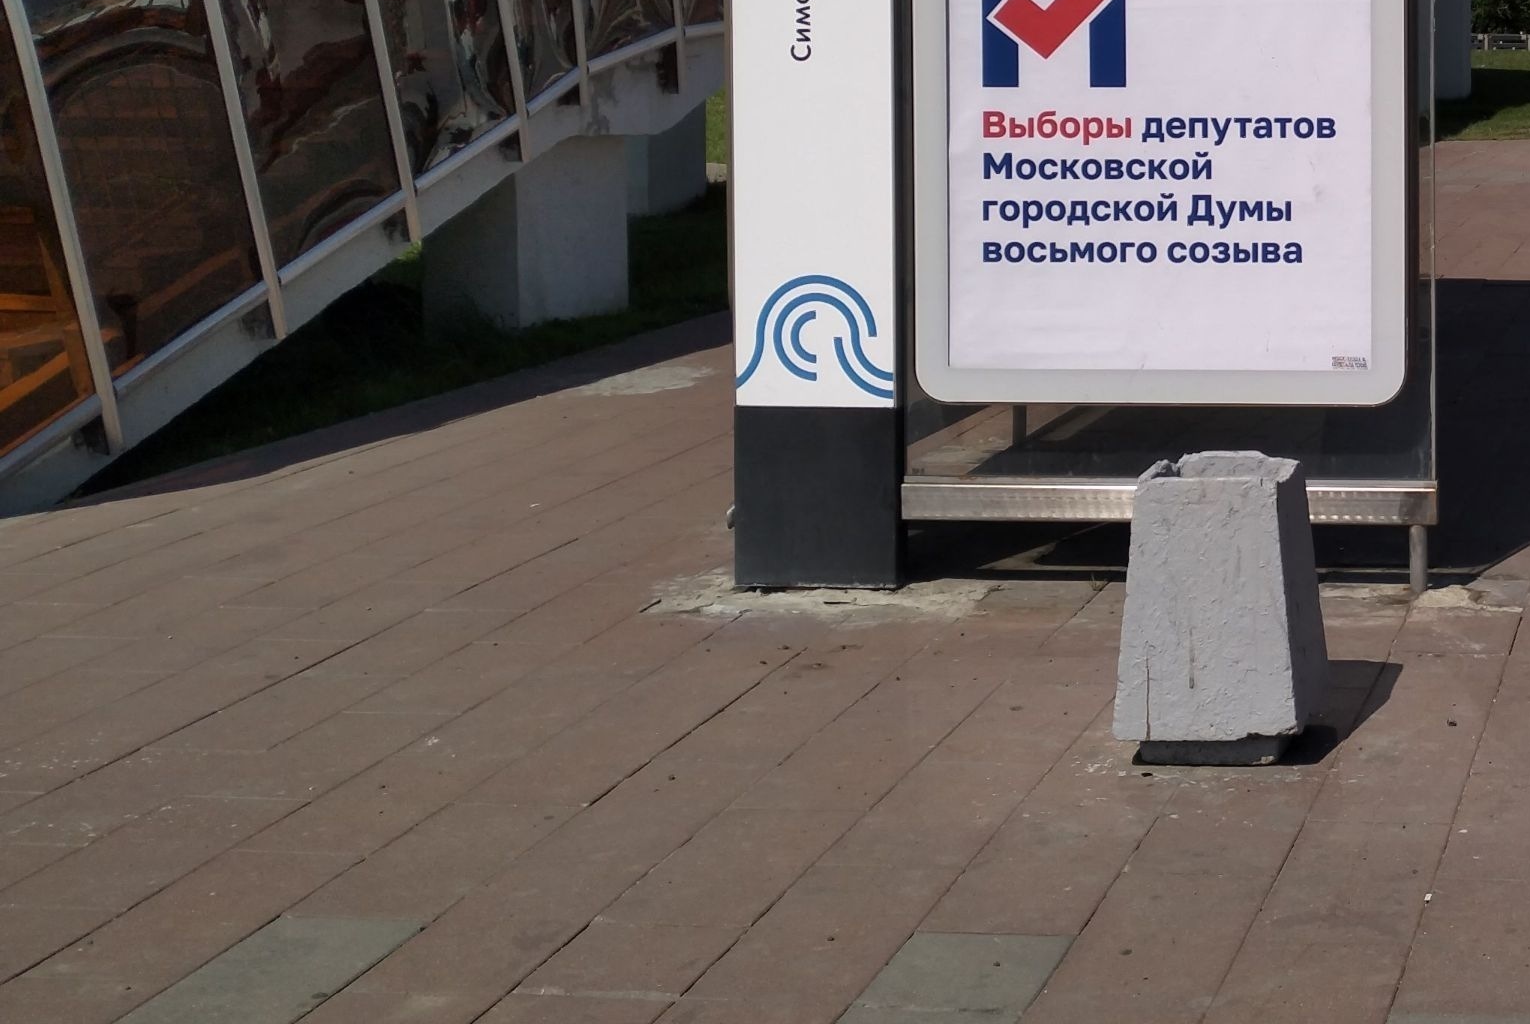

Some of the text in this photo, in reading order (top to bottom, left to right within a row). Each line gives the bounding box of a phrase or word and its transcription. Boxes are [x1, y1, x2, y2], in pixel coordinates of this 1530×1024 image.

[982, 111, 1337, 146] Выборы депутатов
[982, 151, 1213, 180] Московской
[982, 193, 1292, 229] городской Думы
[982, 241, 1304, 263] восьмого созыва
